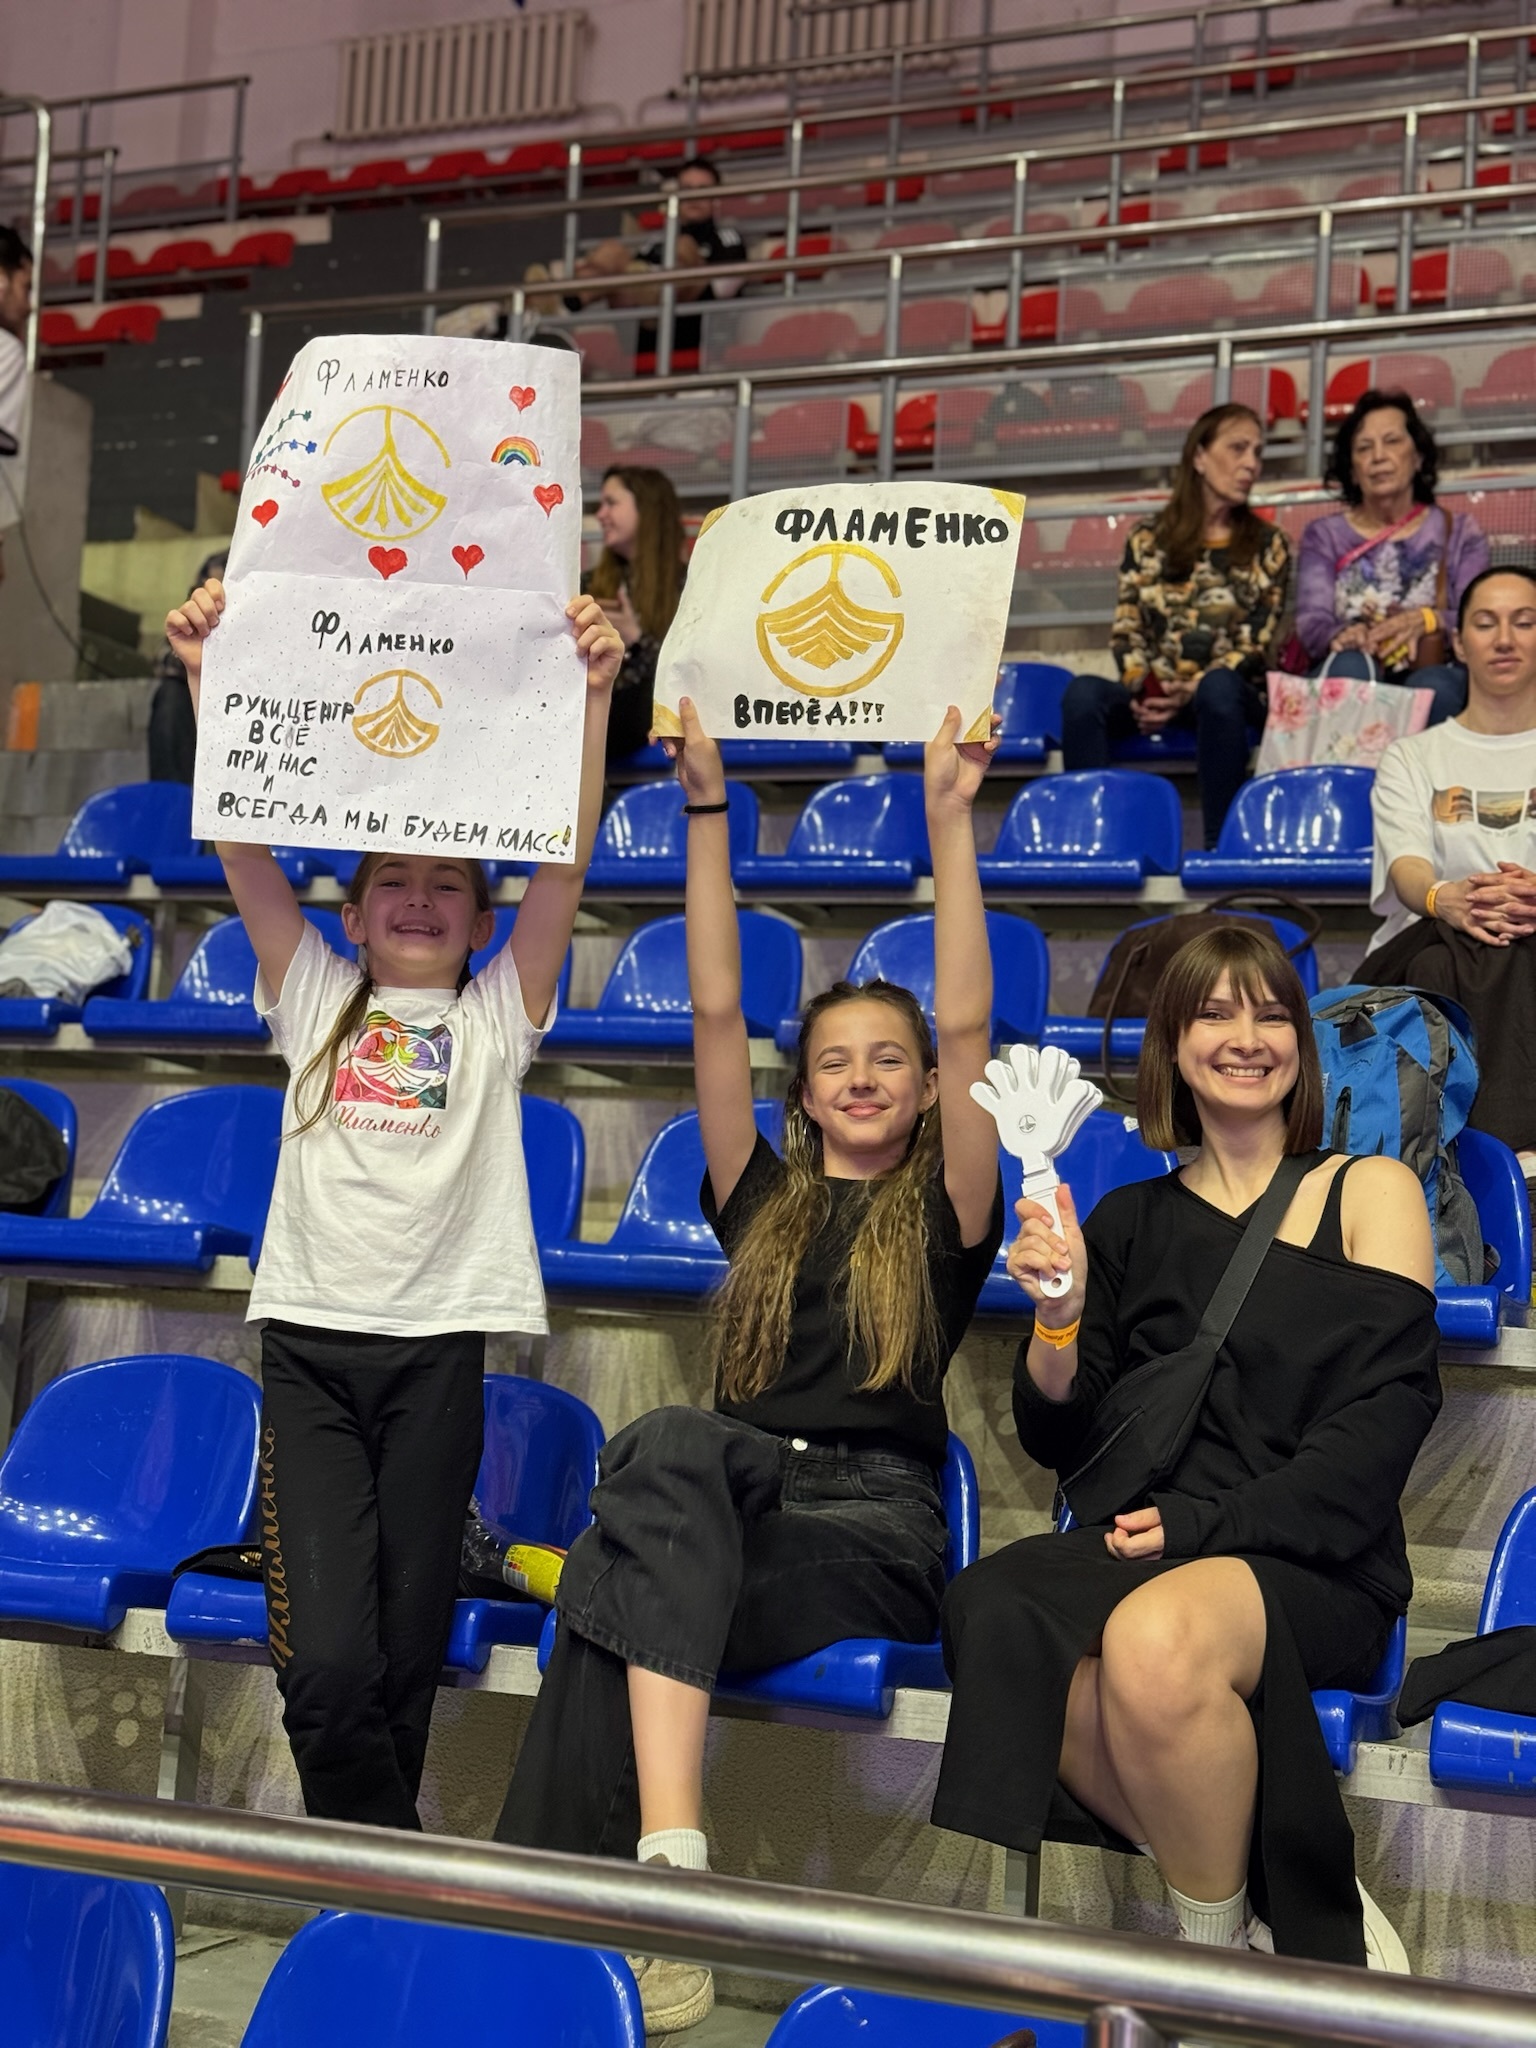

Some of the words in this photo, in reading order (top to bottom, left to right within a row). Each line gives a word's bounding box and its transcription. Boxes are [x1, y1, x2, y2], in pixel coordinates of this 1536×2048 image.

[317, 359, 449, 395] ФЛАМЕНКО
[775, 507, 1009, 548] ФЛАМЕНКО
[312, 610, 454, 655] ФЛАМЕНКО
[734, 694, 886, 728] ВПЕРЁД!!!
[248, 719, 311, 746] ВСЁ
[226, 749, 268, 774] ПРИ
[278, 752, 318, 777] НАС
[217, 791, 328, 826] ВСЕГДА
[345, 810, 389, 835] МЫ
[403, 815, 489, 848] БУДЕМ
[496, 825, 573, 857] КЛАСС!
[335, 1105, 442, 1139] Фламенко
